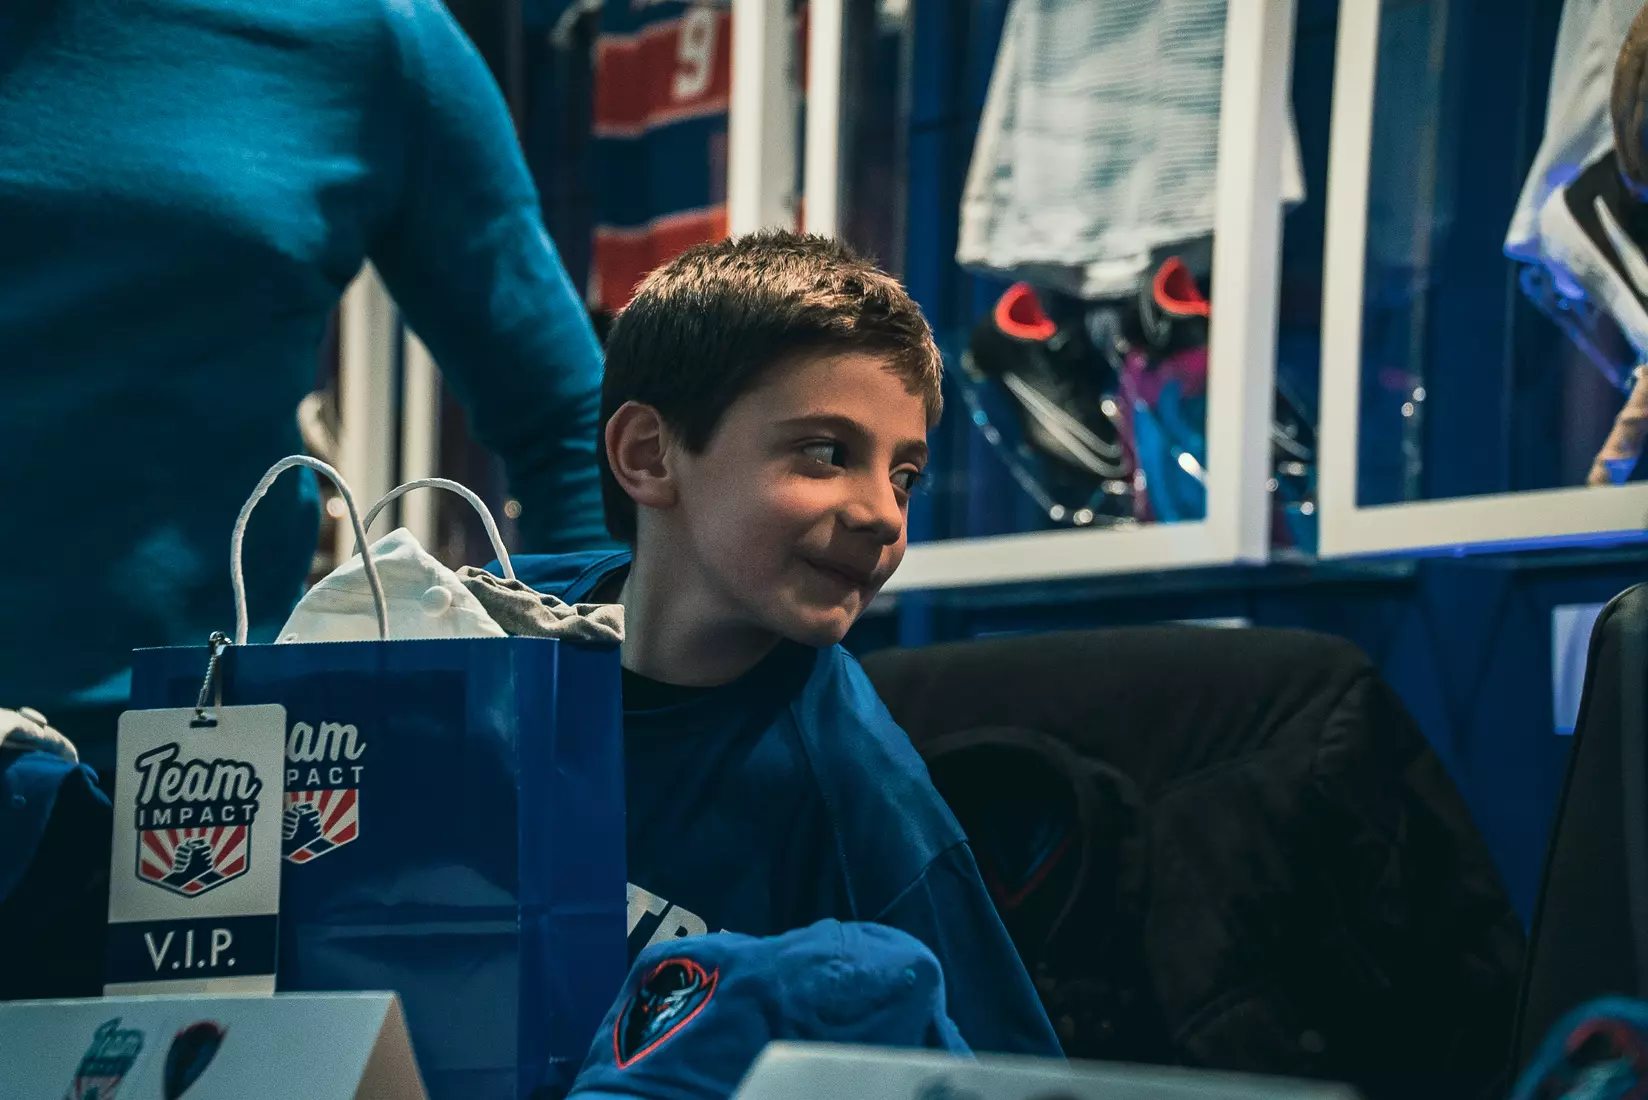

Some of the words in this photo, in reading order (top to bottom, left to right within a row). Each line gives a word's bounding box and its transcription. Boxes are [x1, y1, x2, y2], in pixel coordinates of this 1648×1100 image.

[285, 720, 367, 763] am
[136, 743, 261, 804] Team
[286, 765, 364, 787] PACT
[138, 804, 255, 826] IMPACT
[144, 928, 236, 972] V.I.P.
